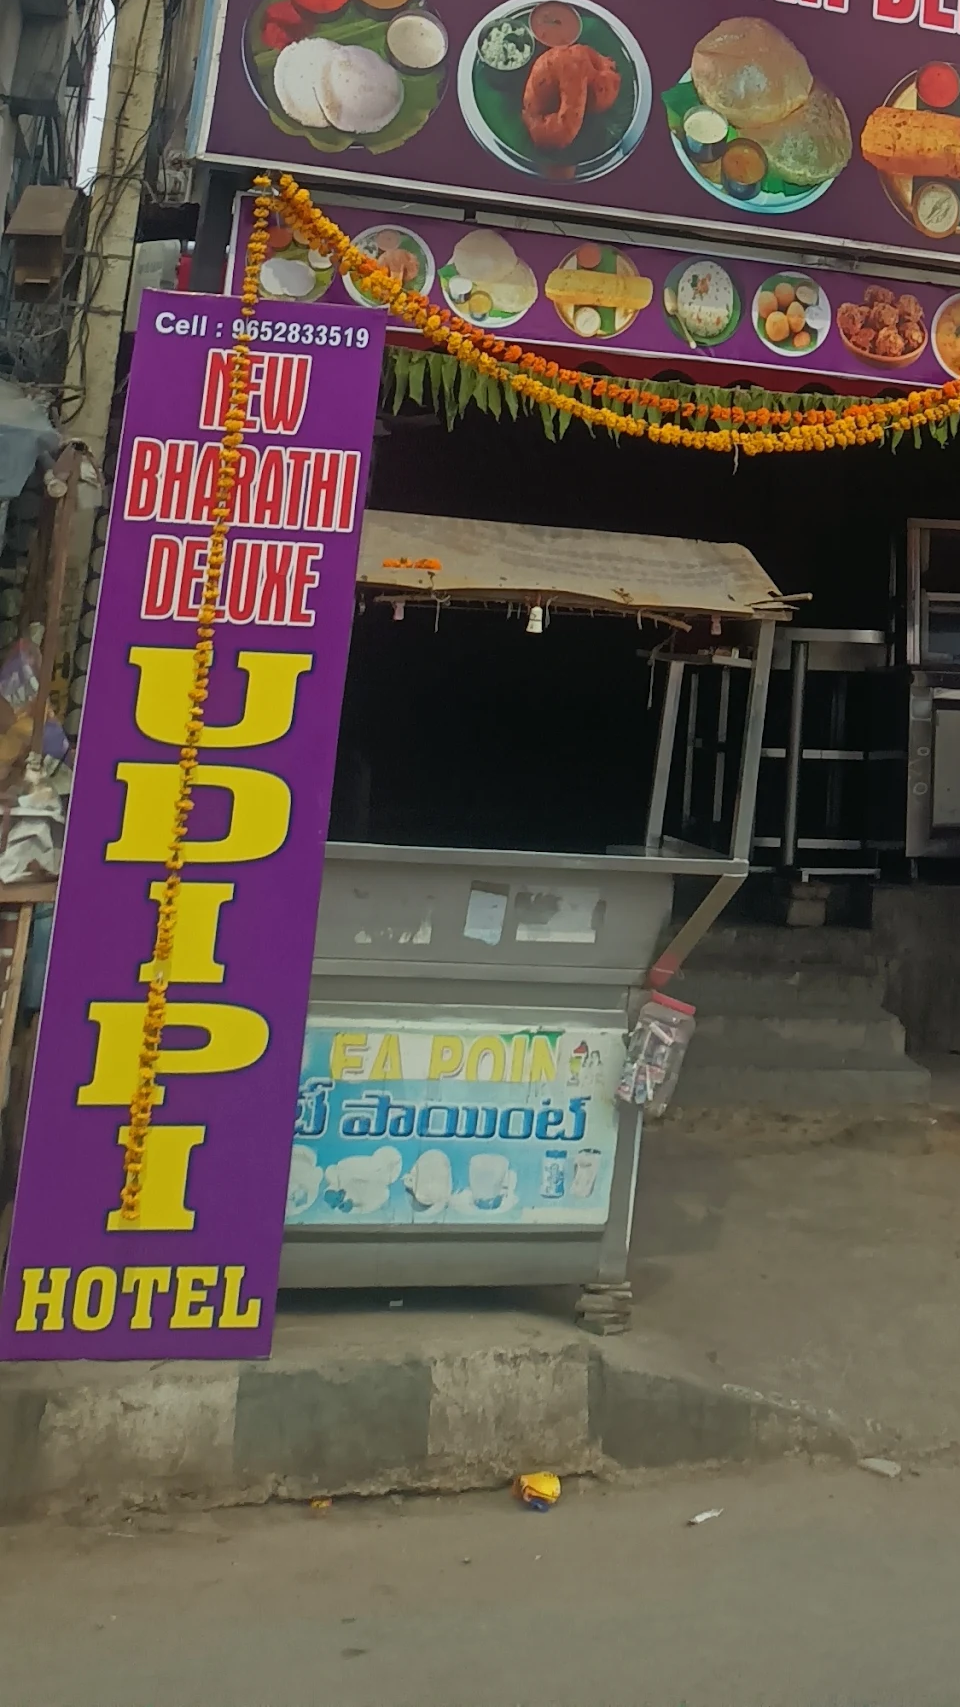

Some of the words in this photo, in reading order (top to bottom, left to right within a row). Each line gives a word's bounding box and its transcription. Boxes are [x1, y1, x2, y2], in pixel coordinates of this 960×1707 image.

[155, 311, 207, 337] Cell
[232, 318, 370, 349] 9652833519
[199, 348, 313, 436] NEW
[123, 436, 362, 533] BHARATHI
[14, 1263, 262, 1334] HOTEL
